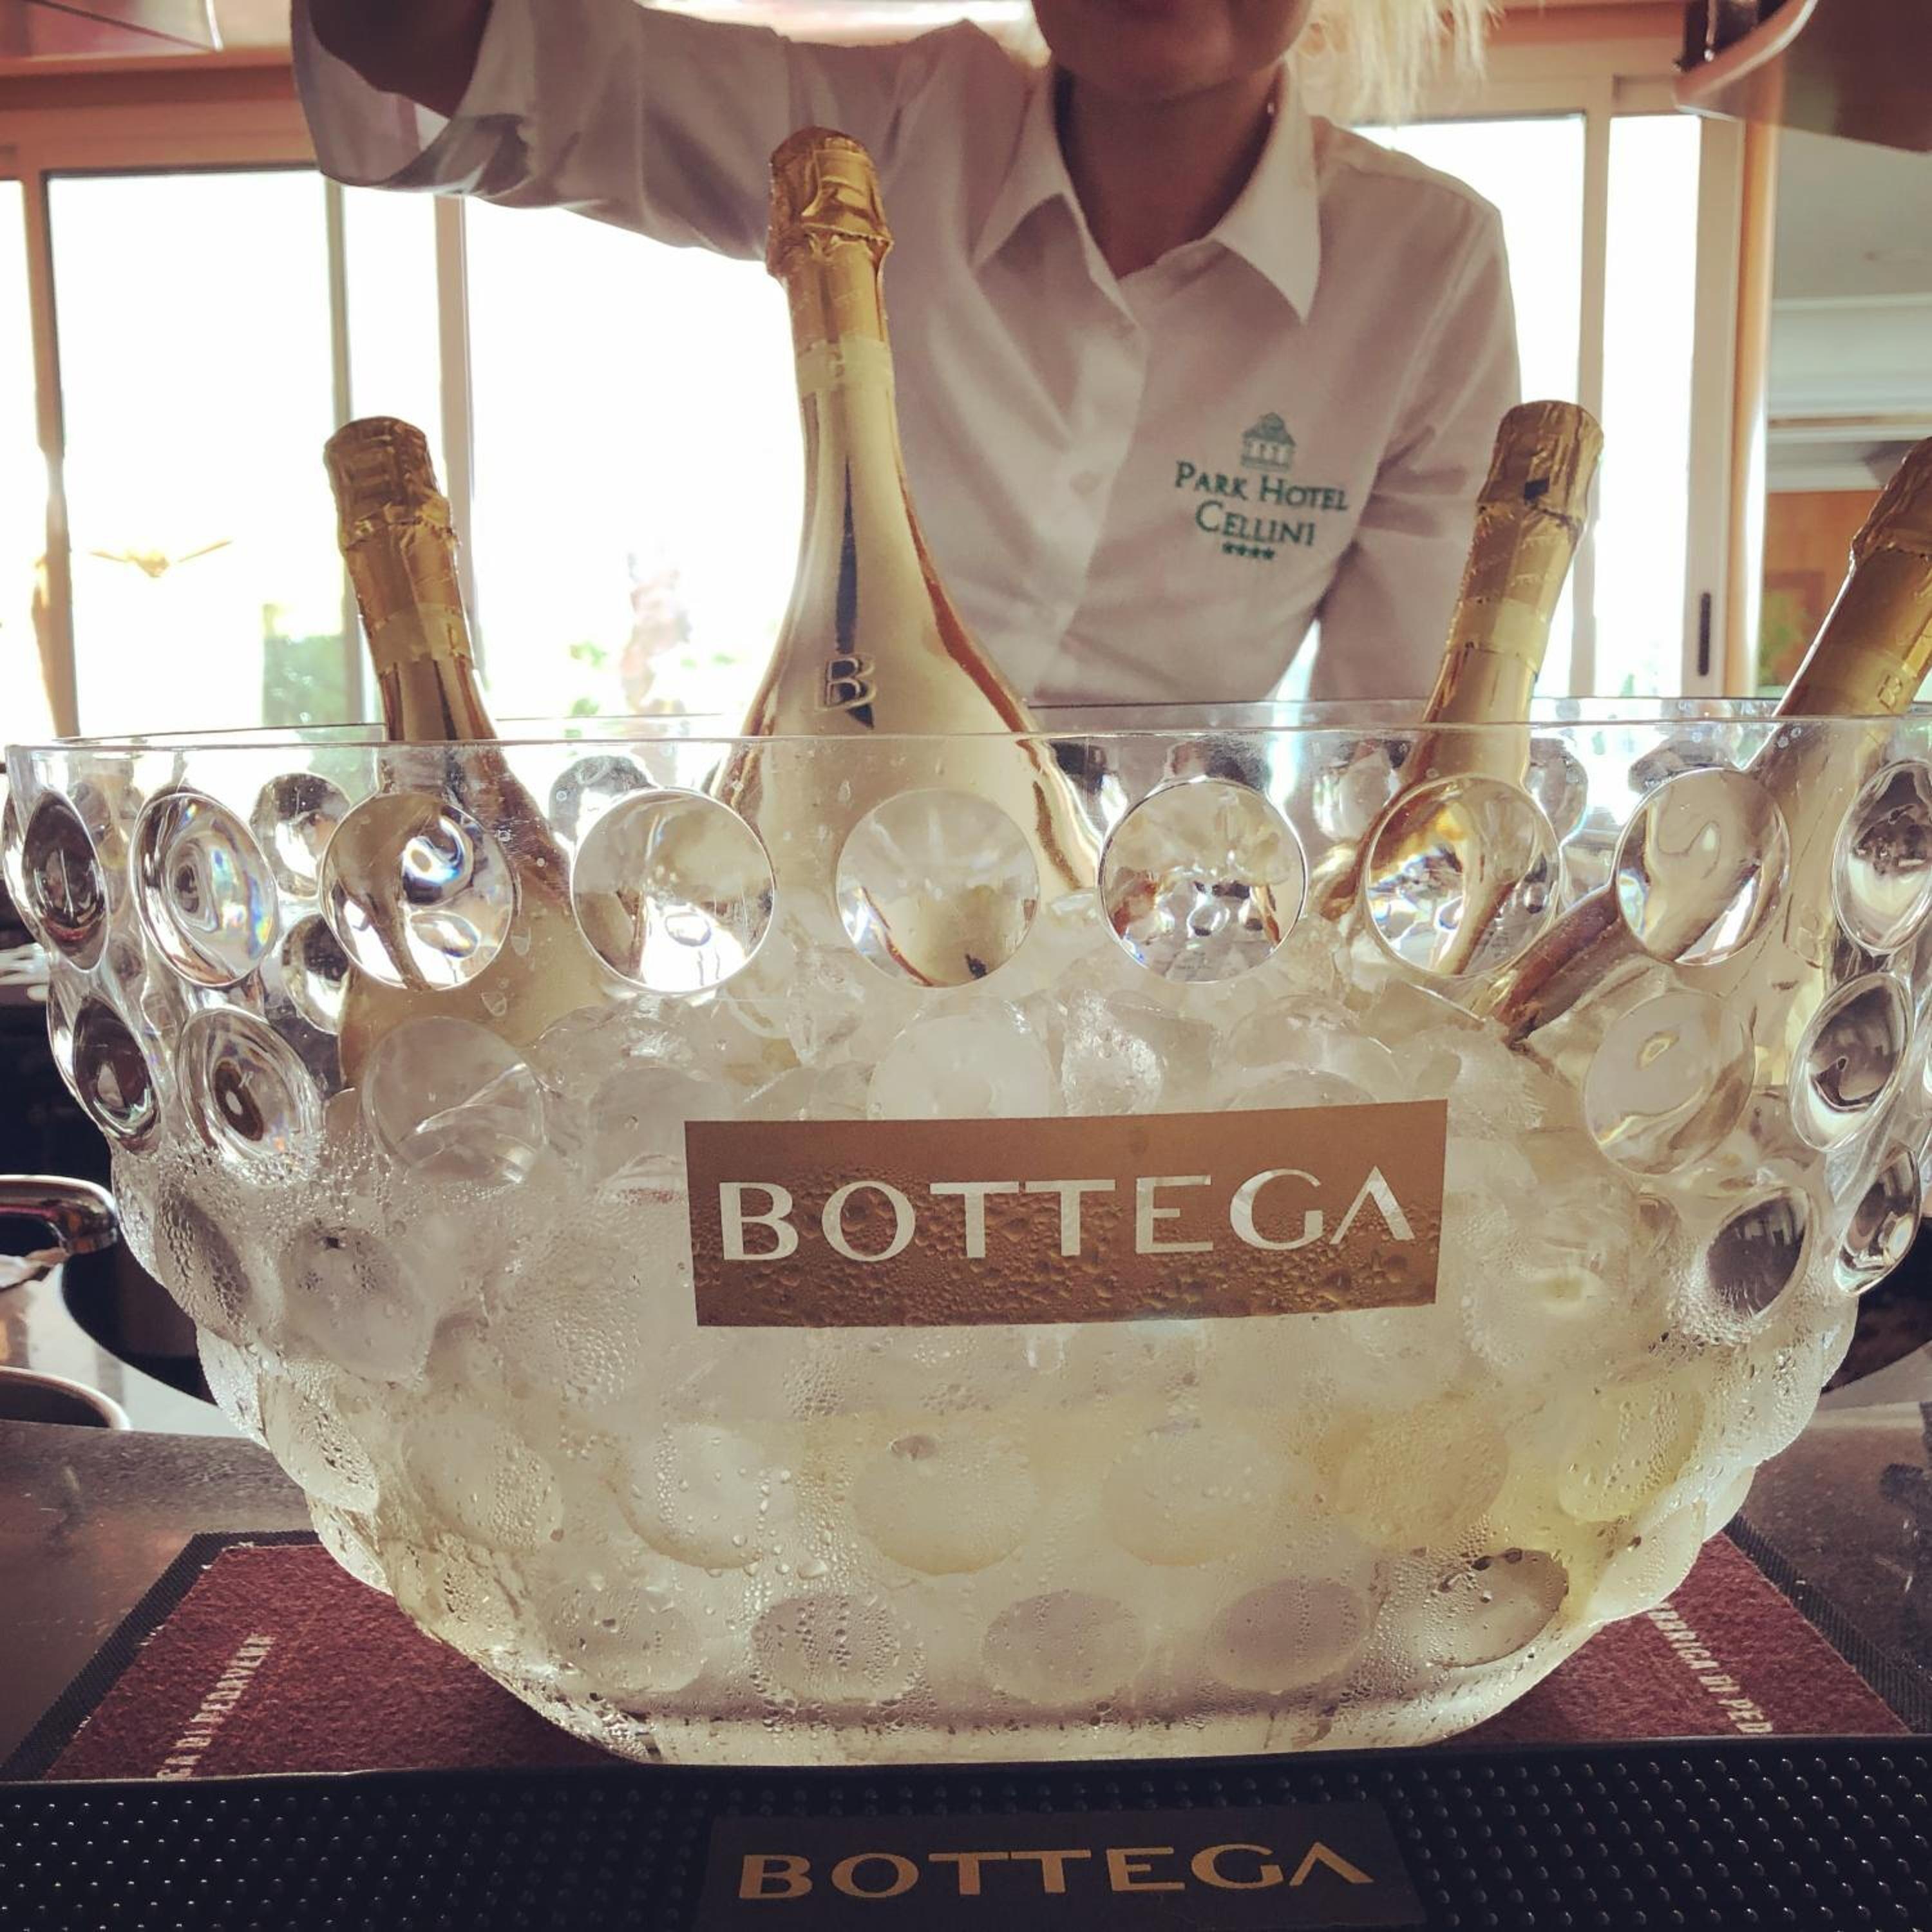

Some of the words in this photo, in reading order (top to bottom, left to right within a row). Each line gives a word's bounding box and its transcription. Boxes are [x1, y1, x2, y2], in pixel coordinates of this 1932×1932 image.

[1175, 460, 1248, 501] PARK
[1260, 475, 1348, 511] HOTEL
[1195, 500, 1315, 547] CELLINI
[815, 653, 876, 710] B
[718, 1164, 1416, 1262] BOTTEGA
[739, 1841, 1375, 1899] BOTTEGA
